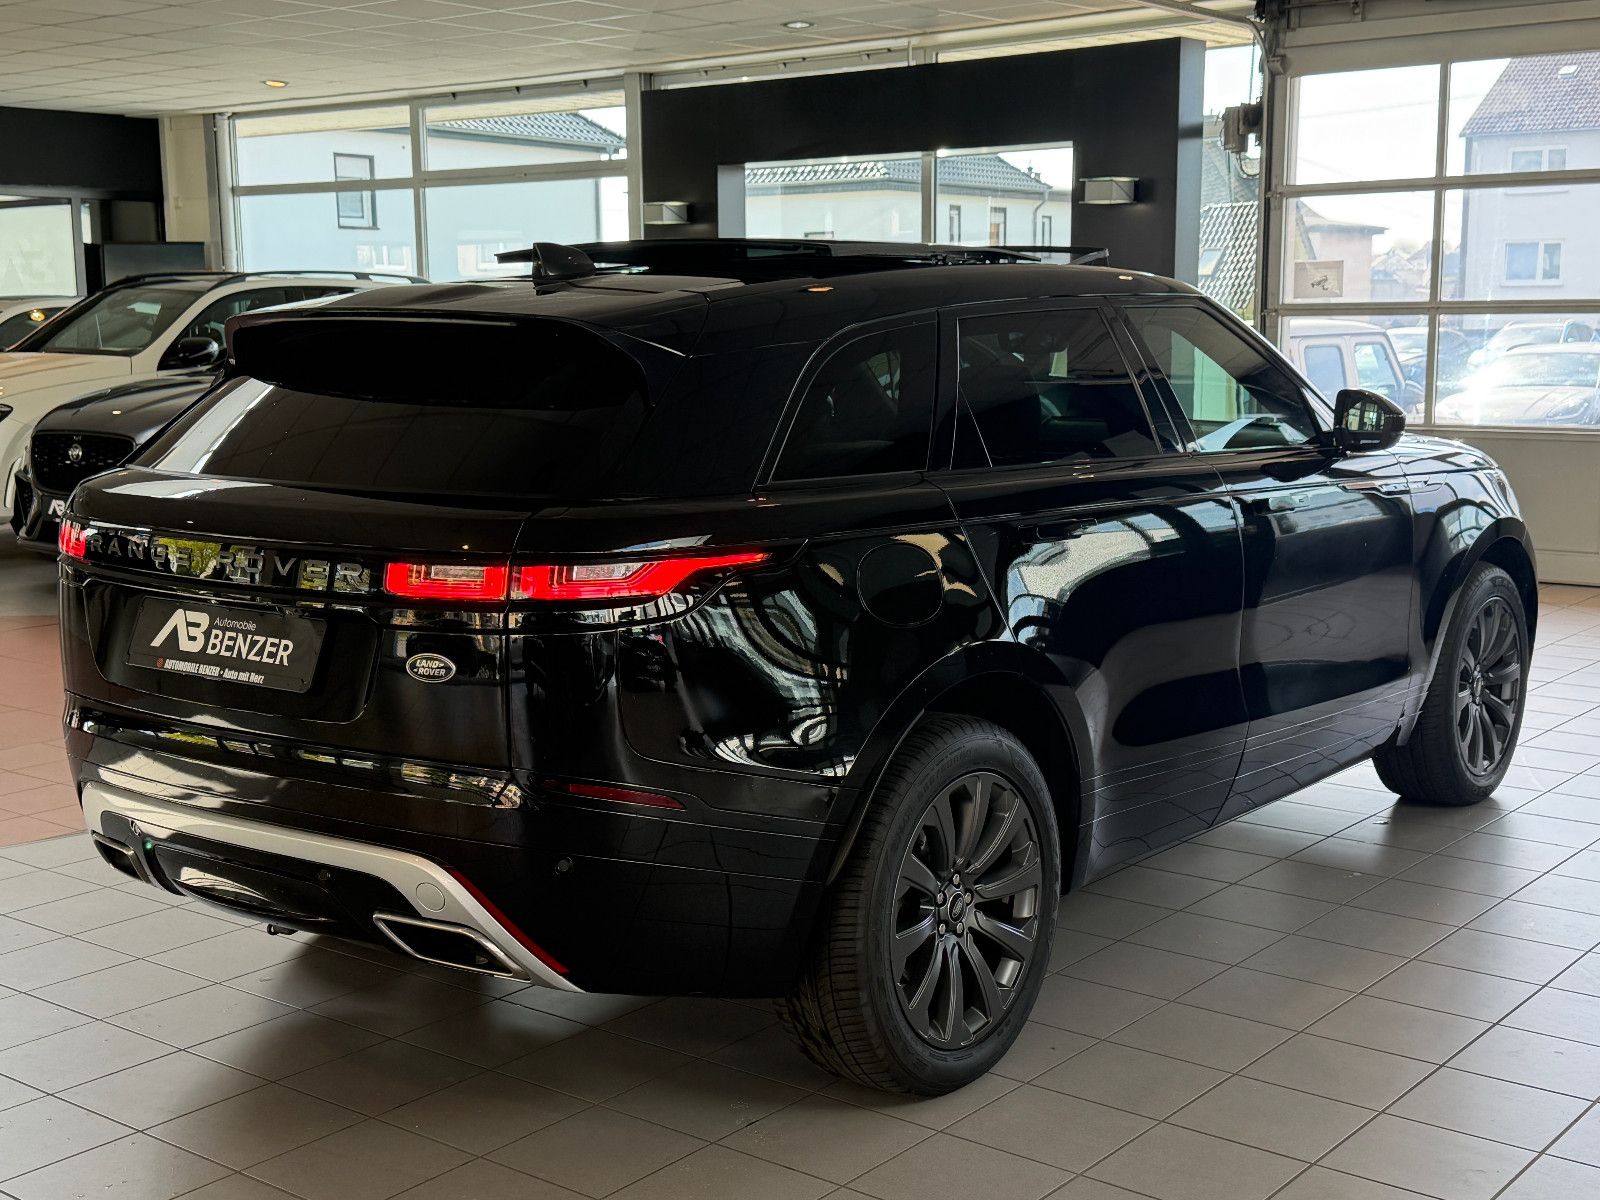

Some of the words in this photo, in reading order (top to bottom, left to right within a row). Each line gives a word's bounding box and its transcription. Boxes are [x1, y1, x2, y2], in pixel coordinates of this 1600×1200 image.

[86, 533, 192, 566] RANGE
[217, 550, 366, 583] ROVER
[213, 617, 257, 631] Automobile
[206, 629, 294, 666] BENZER
[164, 659, 200, 674] AUTOMOBILE
[199, 663, 221, 677] BENZER
[223, 668, 238, 679] Auto
[238, 671, 250, 681] mit
[249, 672, 265, 684] Herz
[417, 668, 446, 677] ROVER
